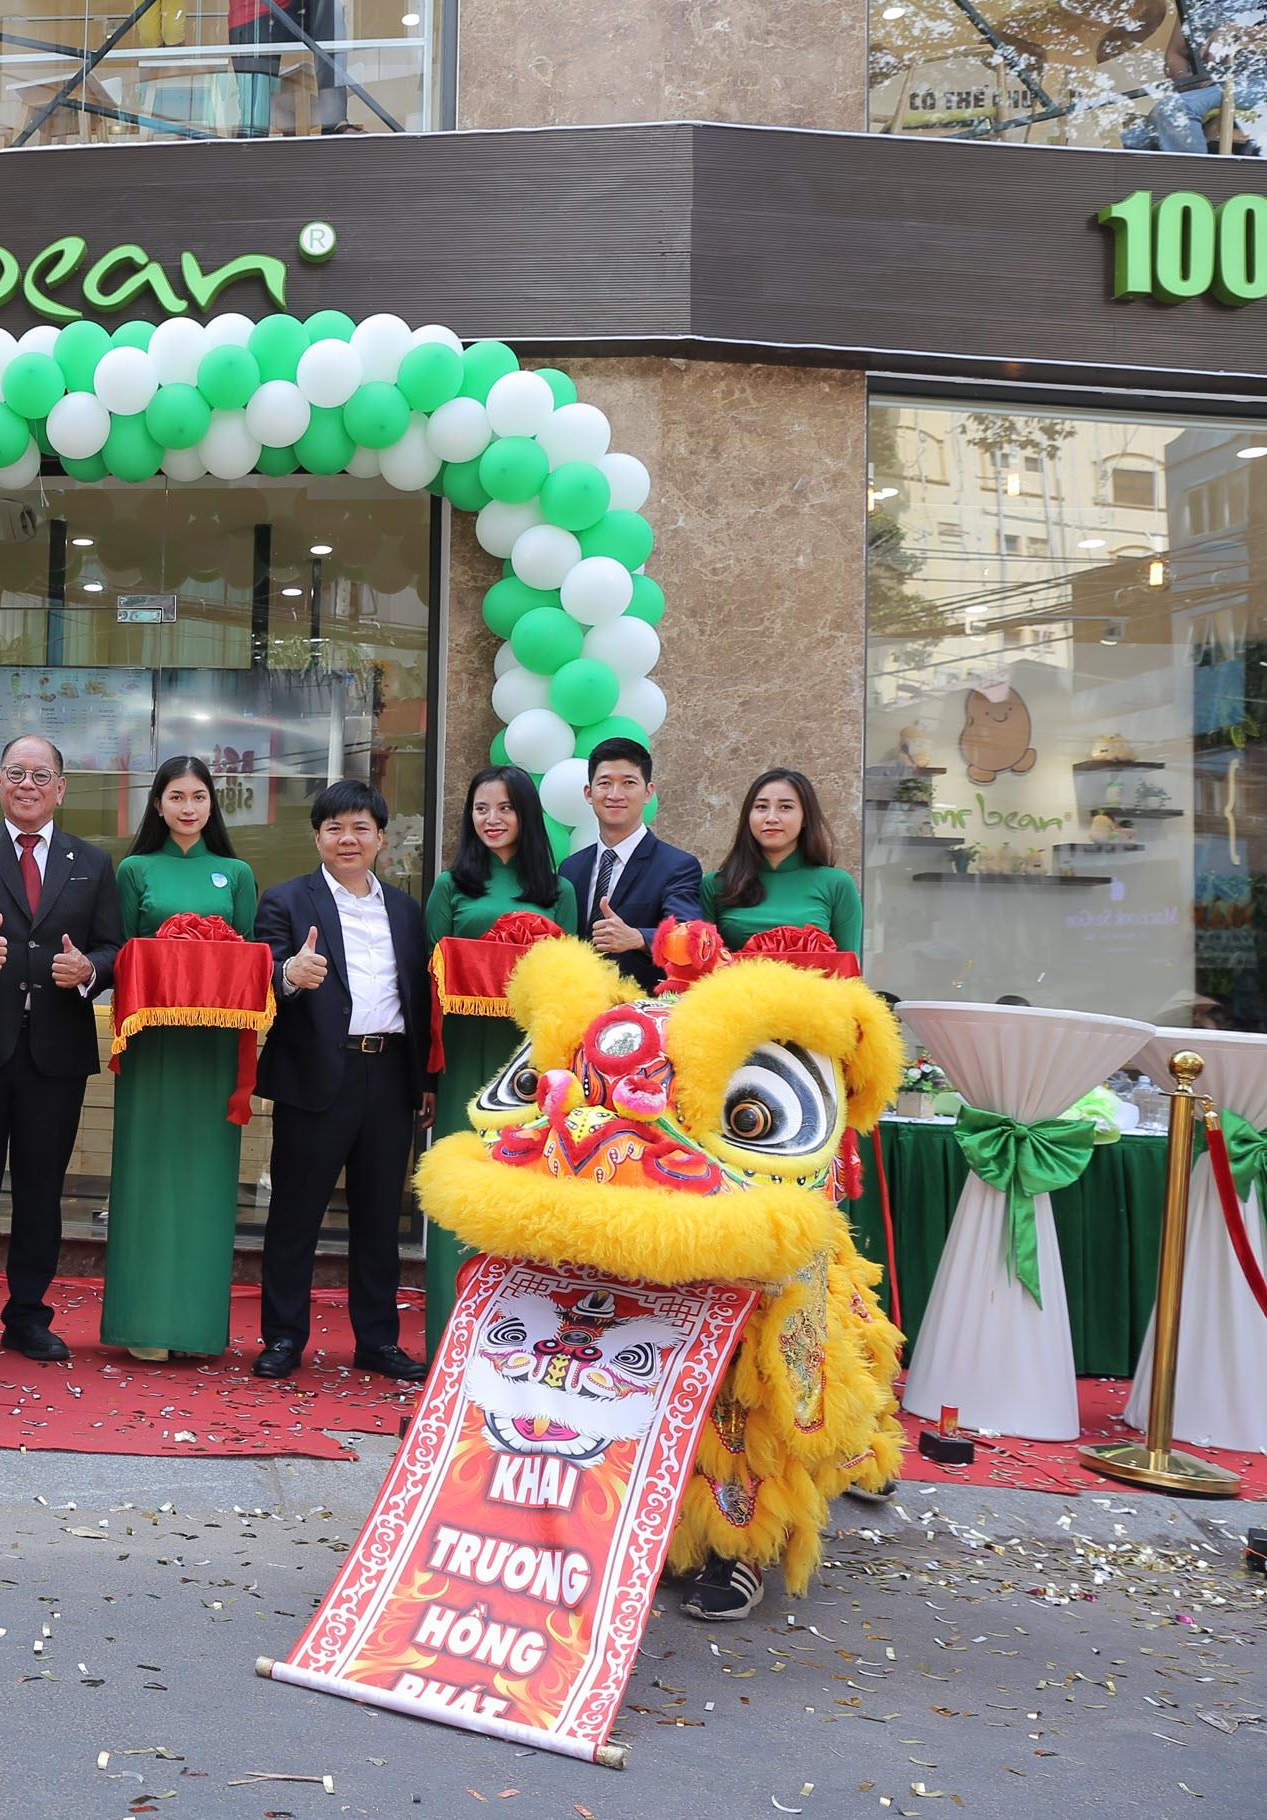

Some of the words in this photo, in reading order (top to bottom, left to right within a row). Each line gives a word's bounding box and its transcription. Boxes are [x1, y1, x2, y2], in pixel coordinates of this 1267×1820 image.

[1099, 190, 1267, 305] 100
[930, 808, 972, 829] mr
[975, 792, 1064, 833] bean
[487, 1453, 581, 1511] KHAI
[427, 1524, 592, 1609] TRƯƠNG
[412, 1602, 548, 1677] HỒNG
